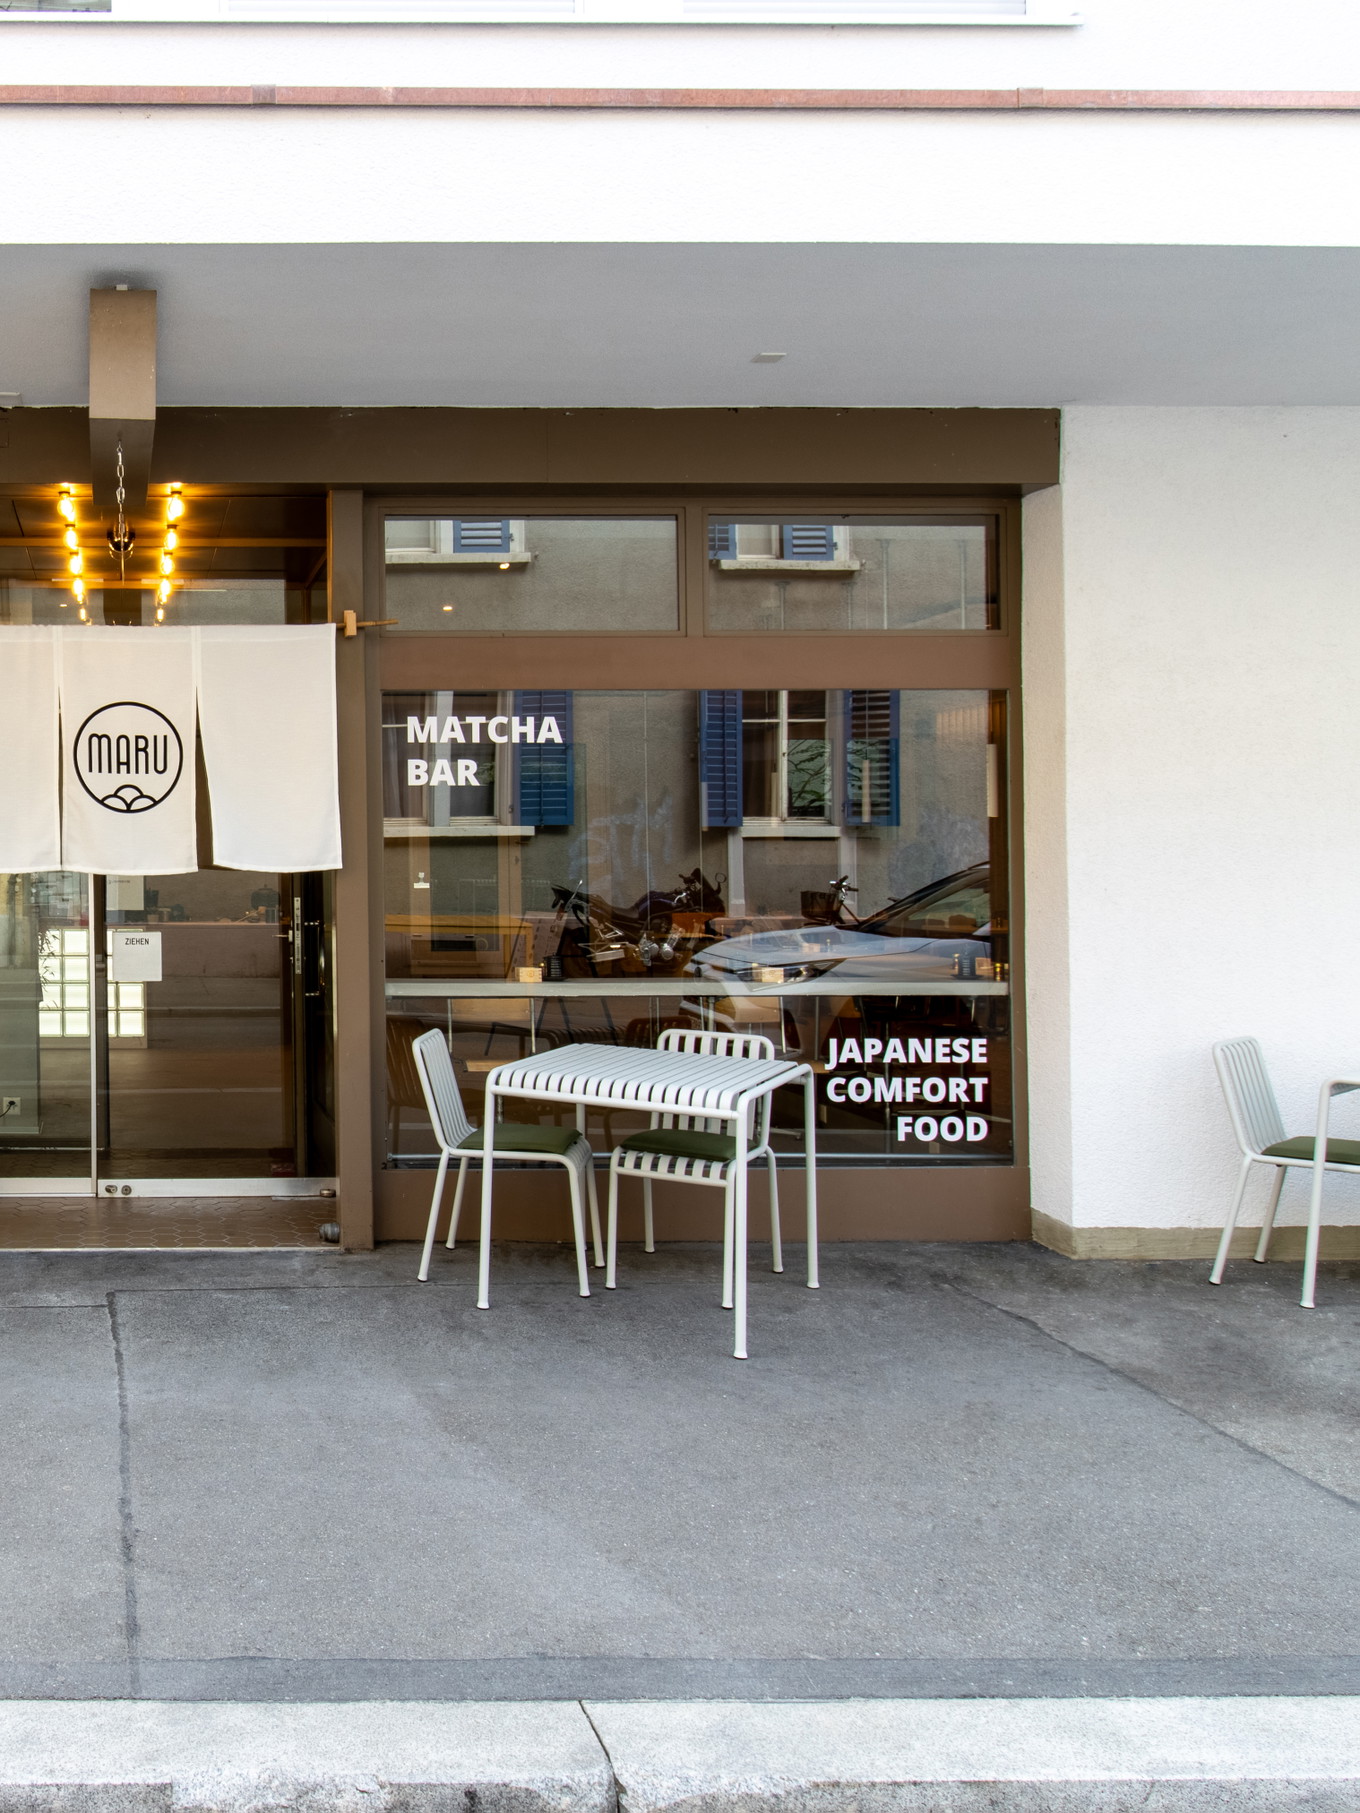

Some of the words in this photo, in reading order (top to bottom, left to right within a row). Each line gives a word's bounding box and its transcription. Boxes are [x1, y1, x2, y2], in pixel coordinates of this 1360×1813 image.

[407, 716, 563, 743] MATCHA
[88, 733, 168, 775] MARU
[407, 759, 480, 786] BAR
[124, 937, 150, 946] ZIEHEN
[824, 1038, 988, 1070] JAPANESE
[827, 1077, 989, 1102] COMFORT
[897, 1116, 989, 1142] FOOD
